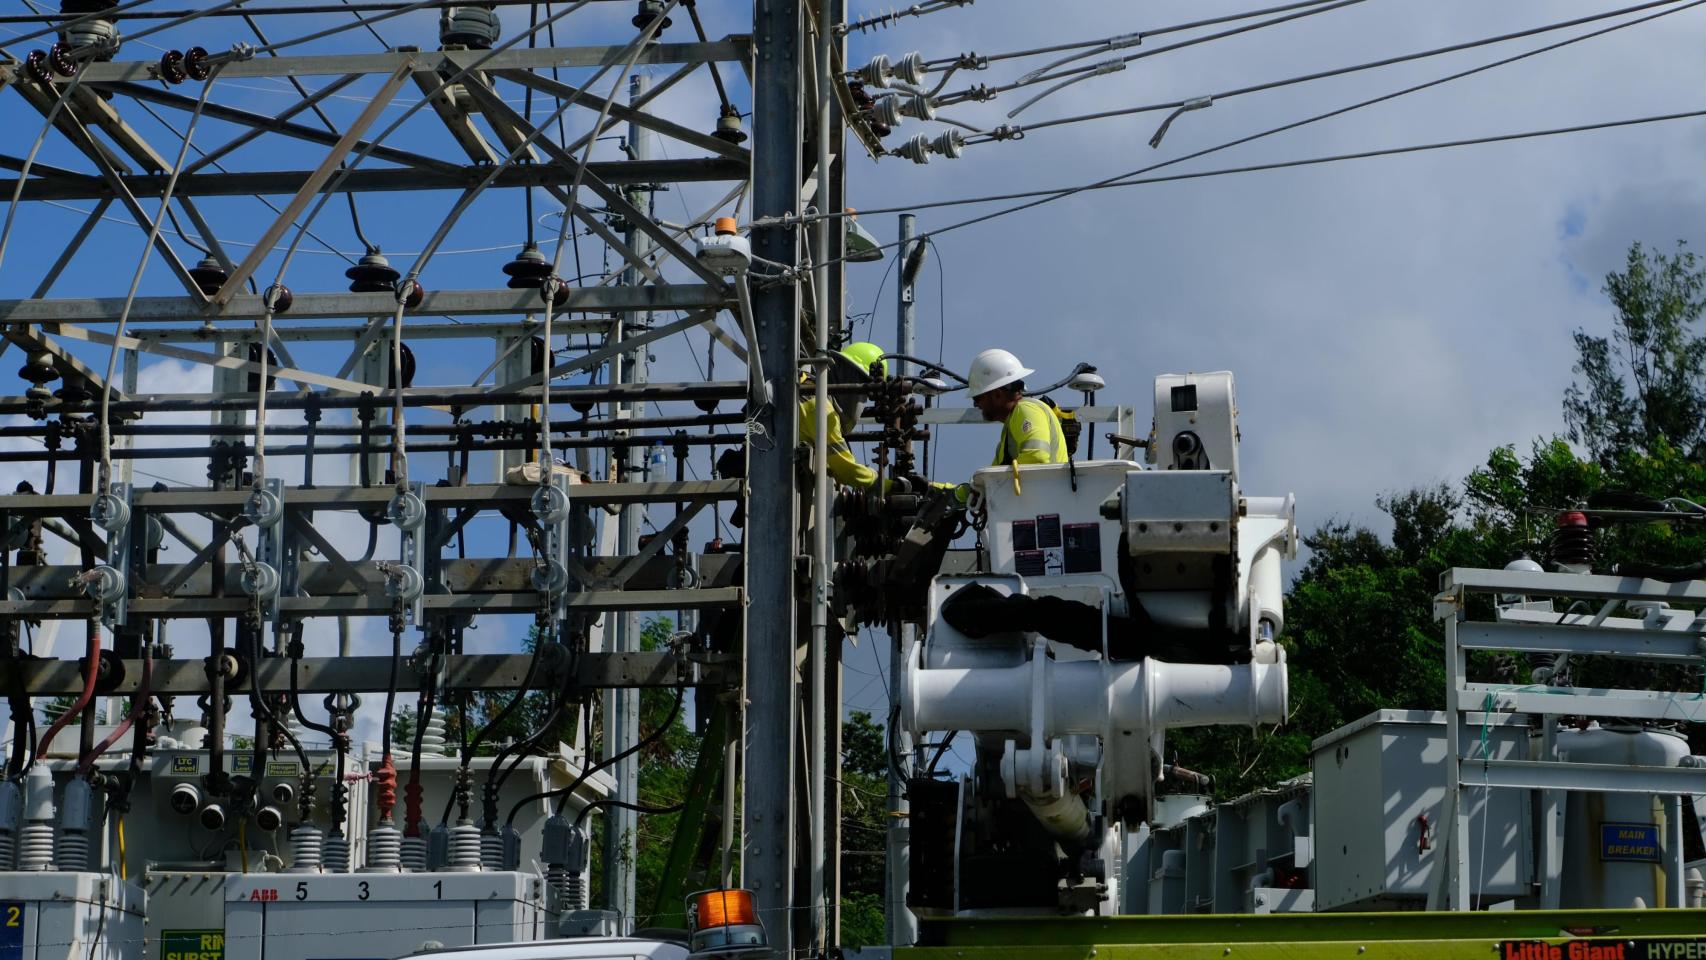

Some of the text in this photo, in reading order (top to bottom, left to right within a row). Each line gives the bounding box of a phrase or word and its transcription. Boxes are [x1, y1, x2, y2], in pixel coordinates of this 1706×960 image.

[175, 765, 196, 773] Level
[178, 757, 192, 765] LTC
[1618, 829, 1646, 840] MAIN
[1607, 845, 1655, 857] BREAKER
[250, 888, 278, 901] ABB
[295, 882, 308, 901] 5
[357, 881, 370, 900] 3
[432, 880, 442, 900] 1
[6, 905, 21, 927] 2
[1505, 940, 1625, 960] Little Giant
